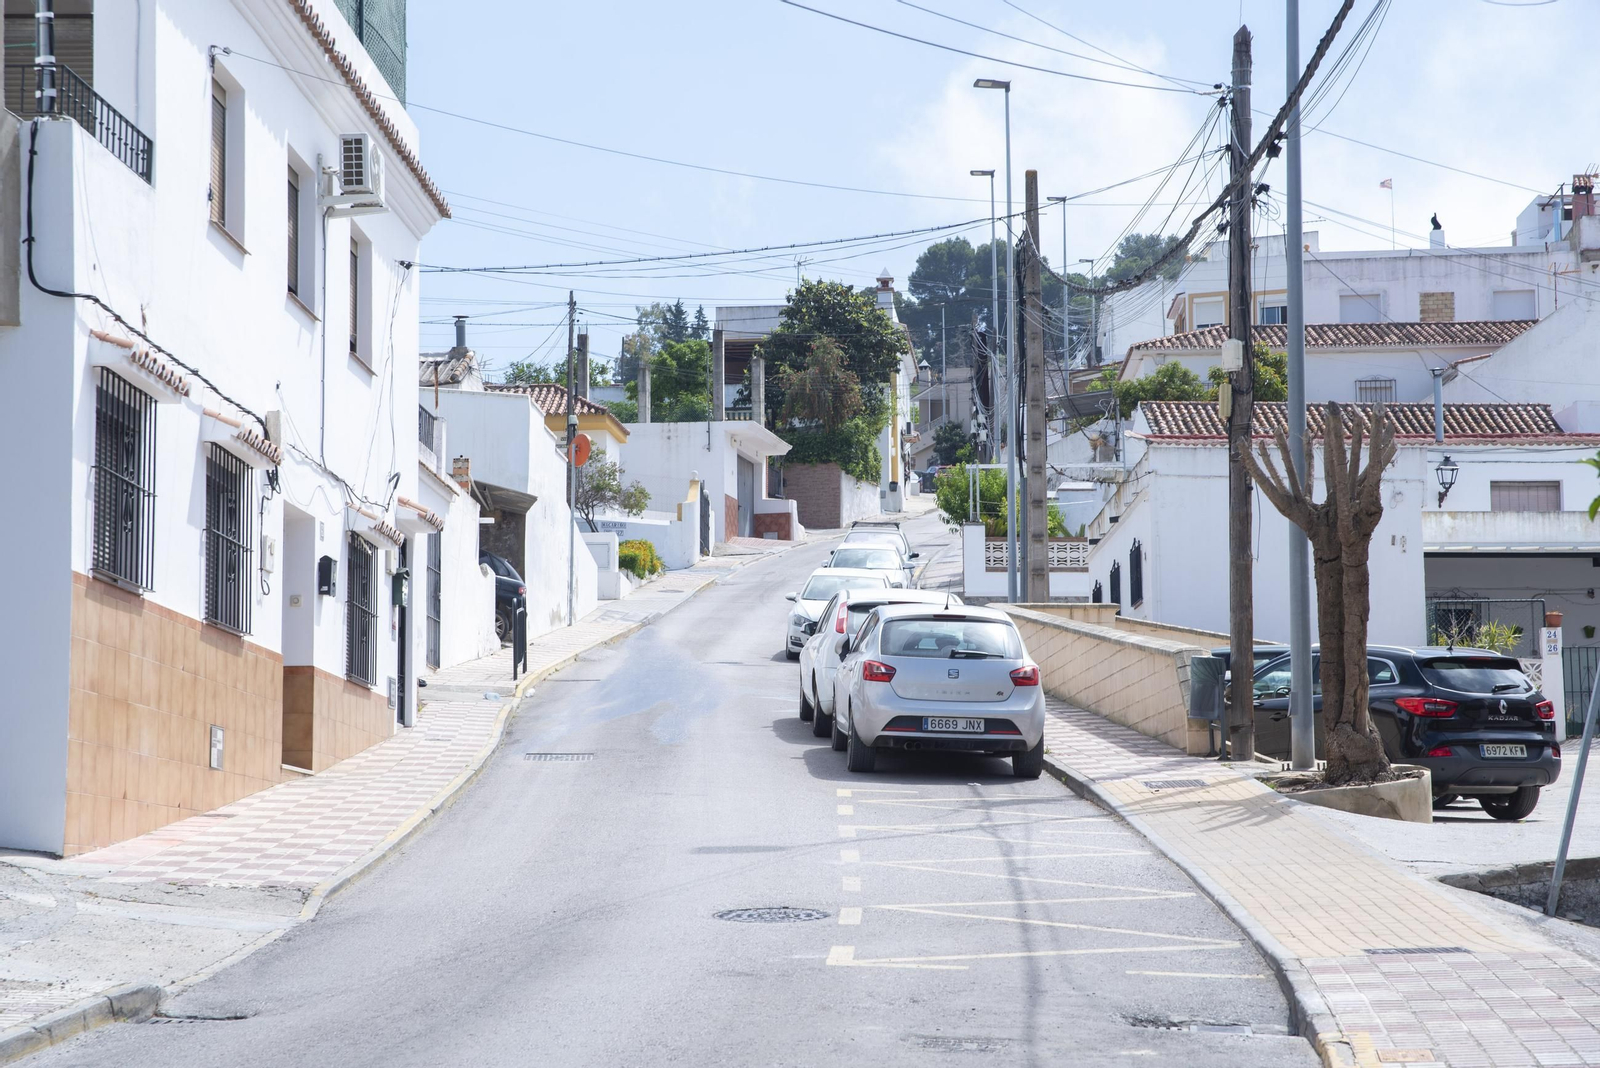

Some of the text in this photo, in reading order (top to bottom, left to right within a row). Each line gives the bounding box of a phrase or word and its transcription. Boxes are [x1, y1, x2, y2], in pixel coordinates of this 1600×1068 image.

[1546, 630, 1557, 639] 24
[1547, 644, 1558, 652] 26
[930, 718, 982, 731] 6669 JNX
[1485, 745, 1508, 756] 6972
